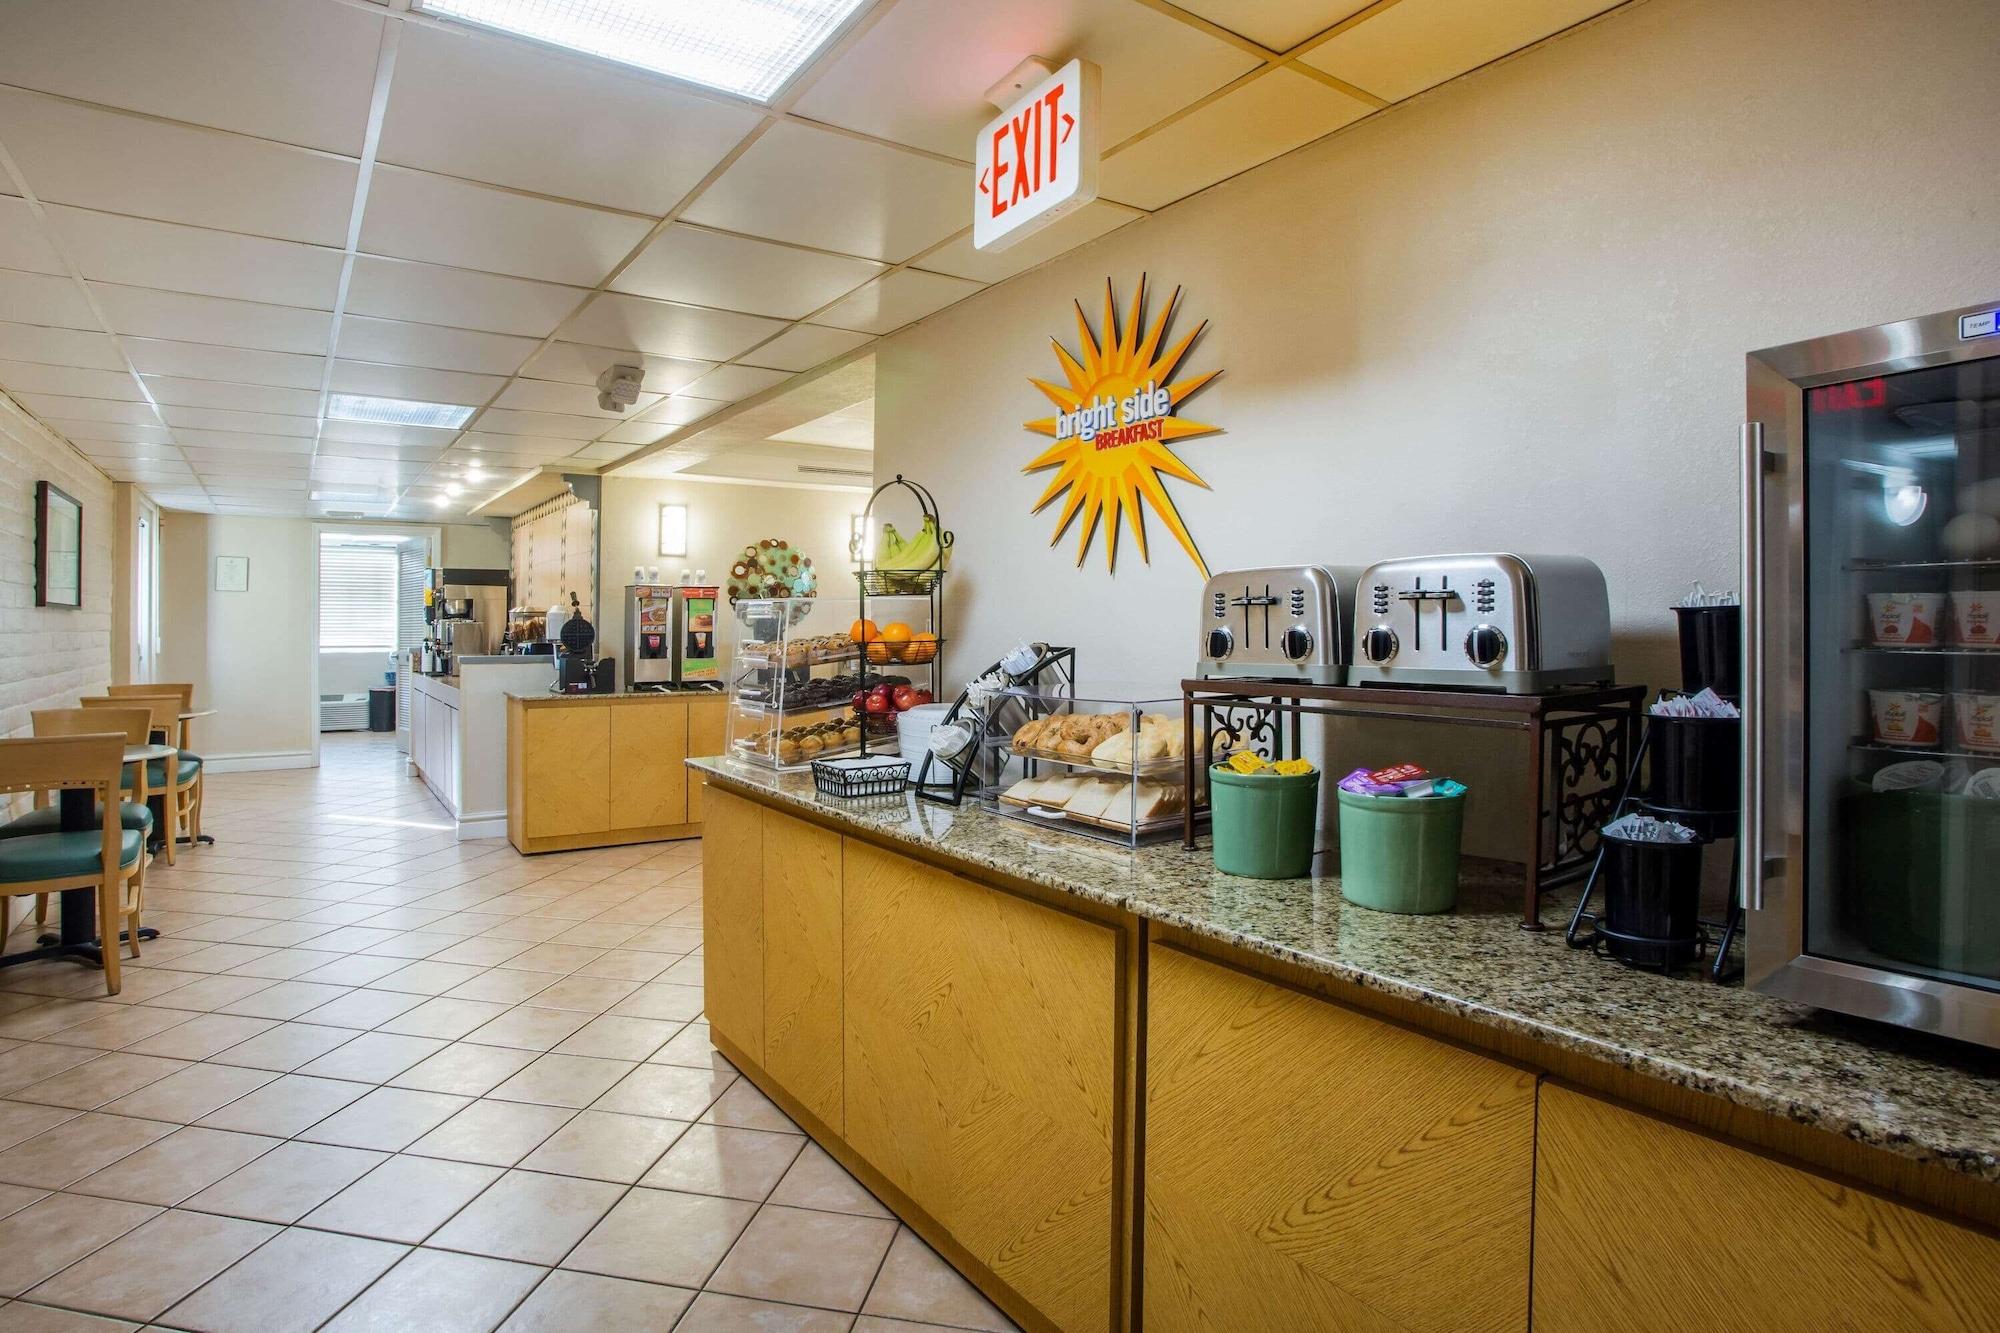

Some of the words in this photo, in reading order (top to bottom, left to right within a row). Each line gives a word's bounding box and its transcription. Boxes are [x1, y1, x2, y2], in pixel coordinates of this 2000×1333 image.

[992, 83, 1064, 219] EXIT
[1055, 395, 1117, 441] bright
[1121, 379, 1172, 424] side
[1095, 418, 1165, 452] BREAKFAST
